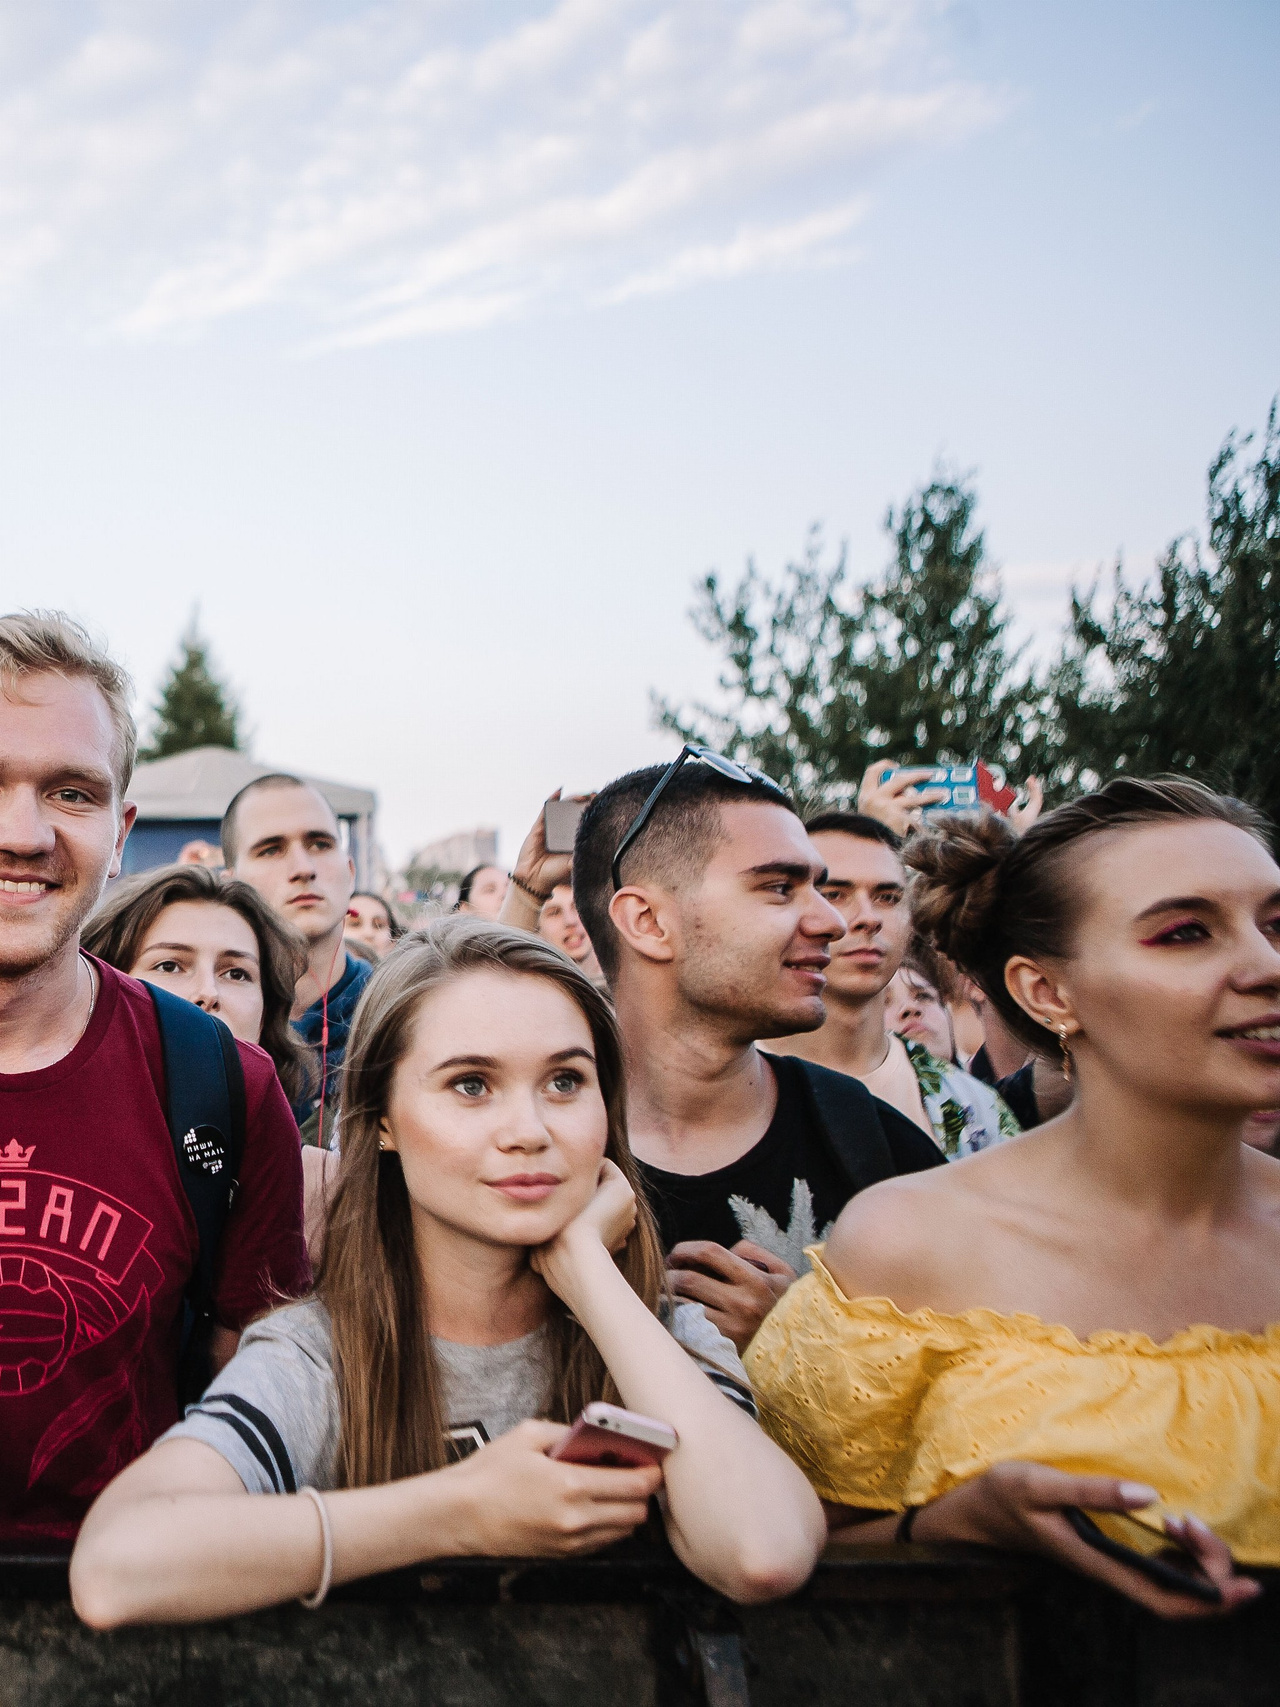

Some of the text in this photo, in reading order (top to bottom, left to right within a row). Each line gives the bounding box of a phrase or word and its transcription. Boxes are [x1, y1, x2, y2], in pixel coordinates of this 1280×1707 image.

[187, 1141, 213, 1153] ПИШИ
[189, 1147, 225, 1162] НА MAIL
